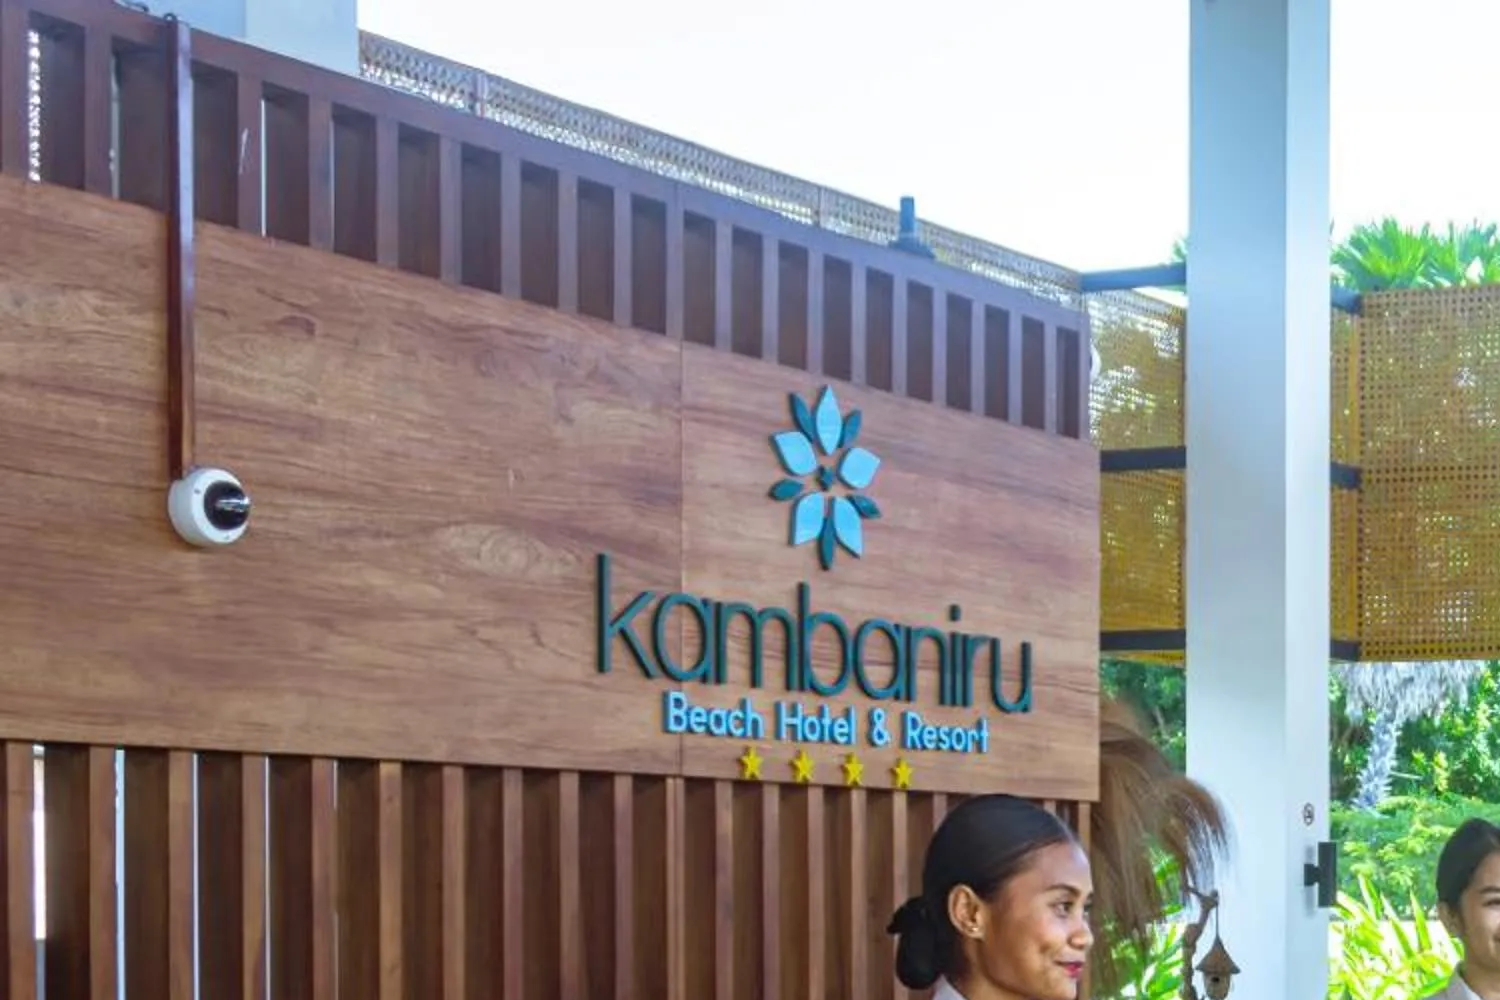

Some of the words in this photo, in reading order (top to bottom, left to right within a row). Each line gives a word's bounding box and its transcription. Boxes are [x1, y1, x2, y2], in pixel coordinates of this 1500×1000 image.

[596, 552, 1032, 713] kambaniru
[664, 690, 763, 739] Beach
[775, 701, 856, 745] Hotel
[869, 707, 890, 746] &
[904, 709, 989, 753] Resort
